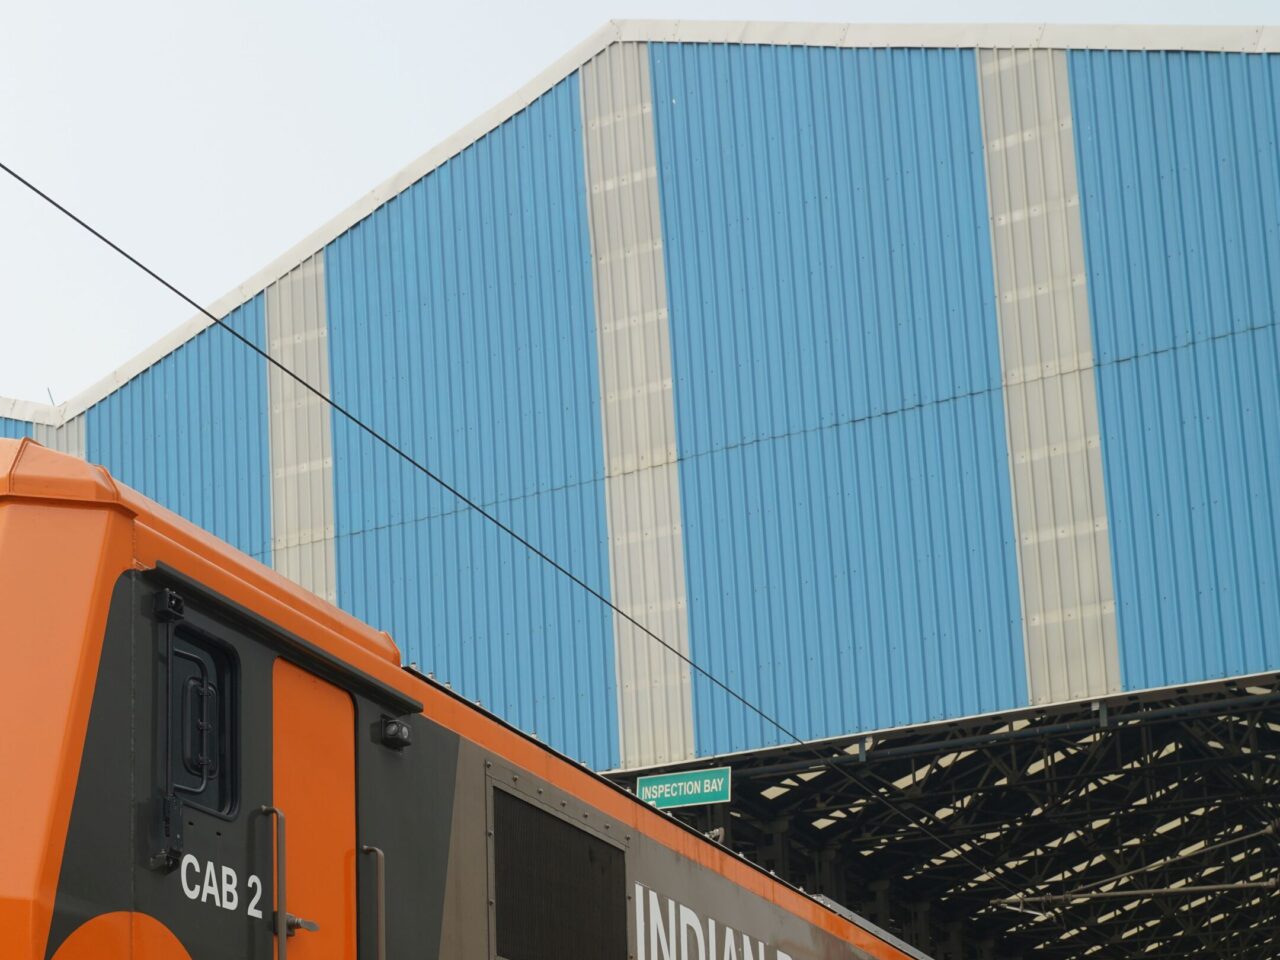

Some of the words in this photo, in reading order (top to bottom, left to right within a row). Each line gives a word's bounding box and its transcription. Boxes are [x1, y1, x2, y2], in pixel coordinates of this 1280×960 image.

[642, 780, 702, 800] INSPECTION
[703, 777, 724, 793] BAY
[181, 853, 239, 911] CAB
[247, 874, 263, 919] 2
